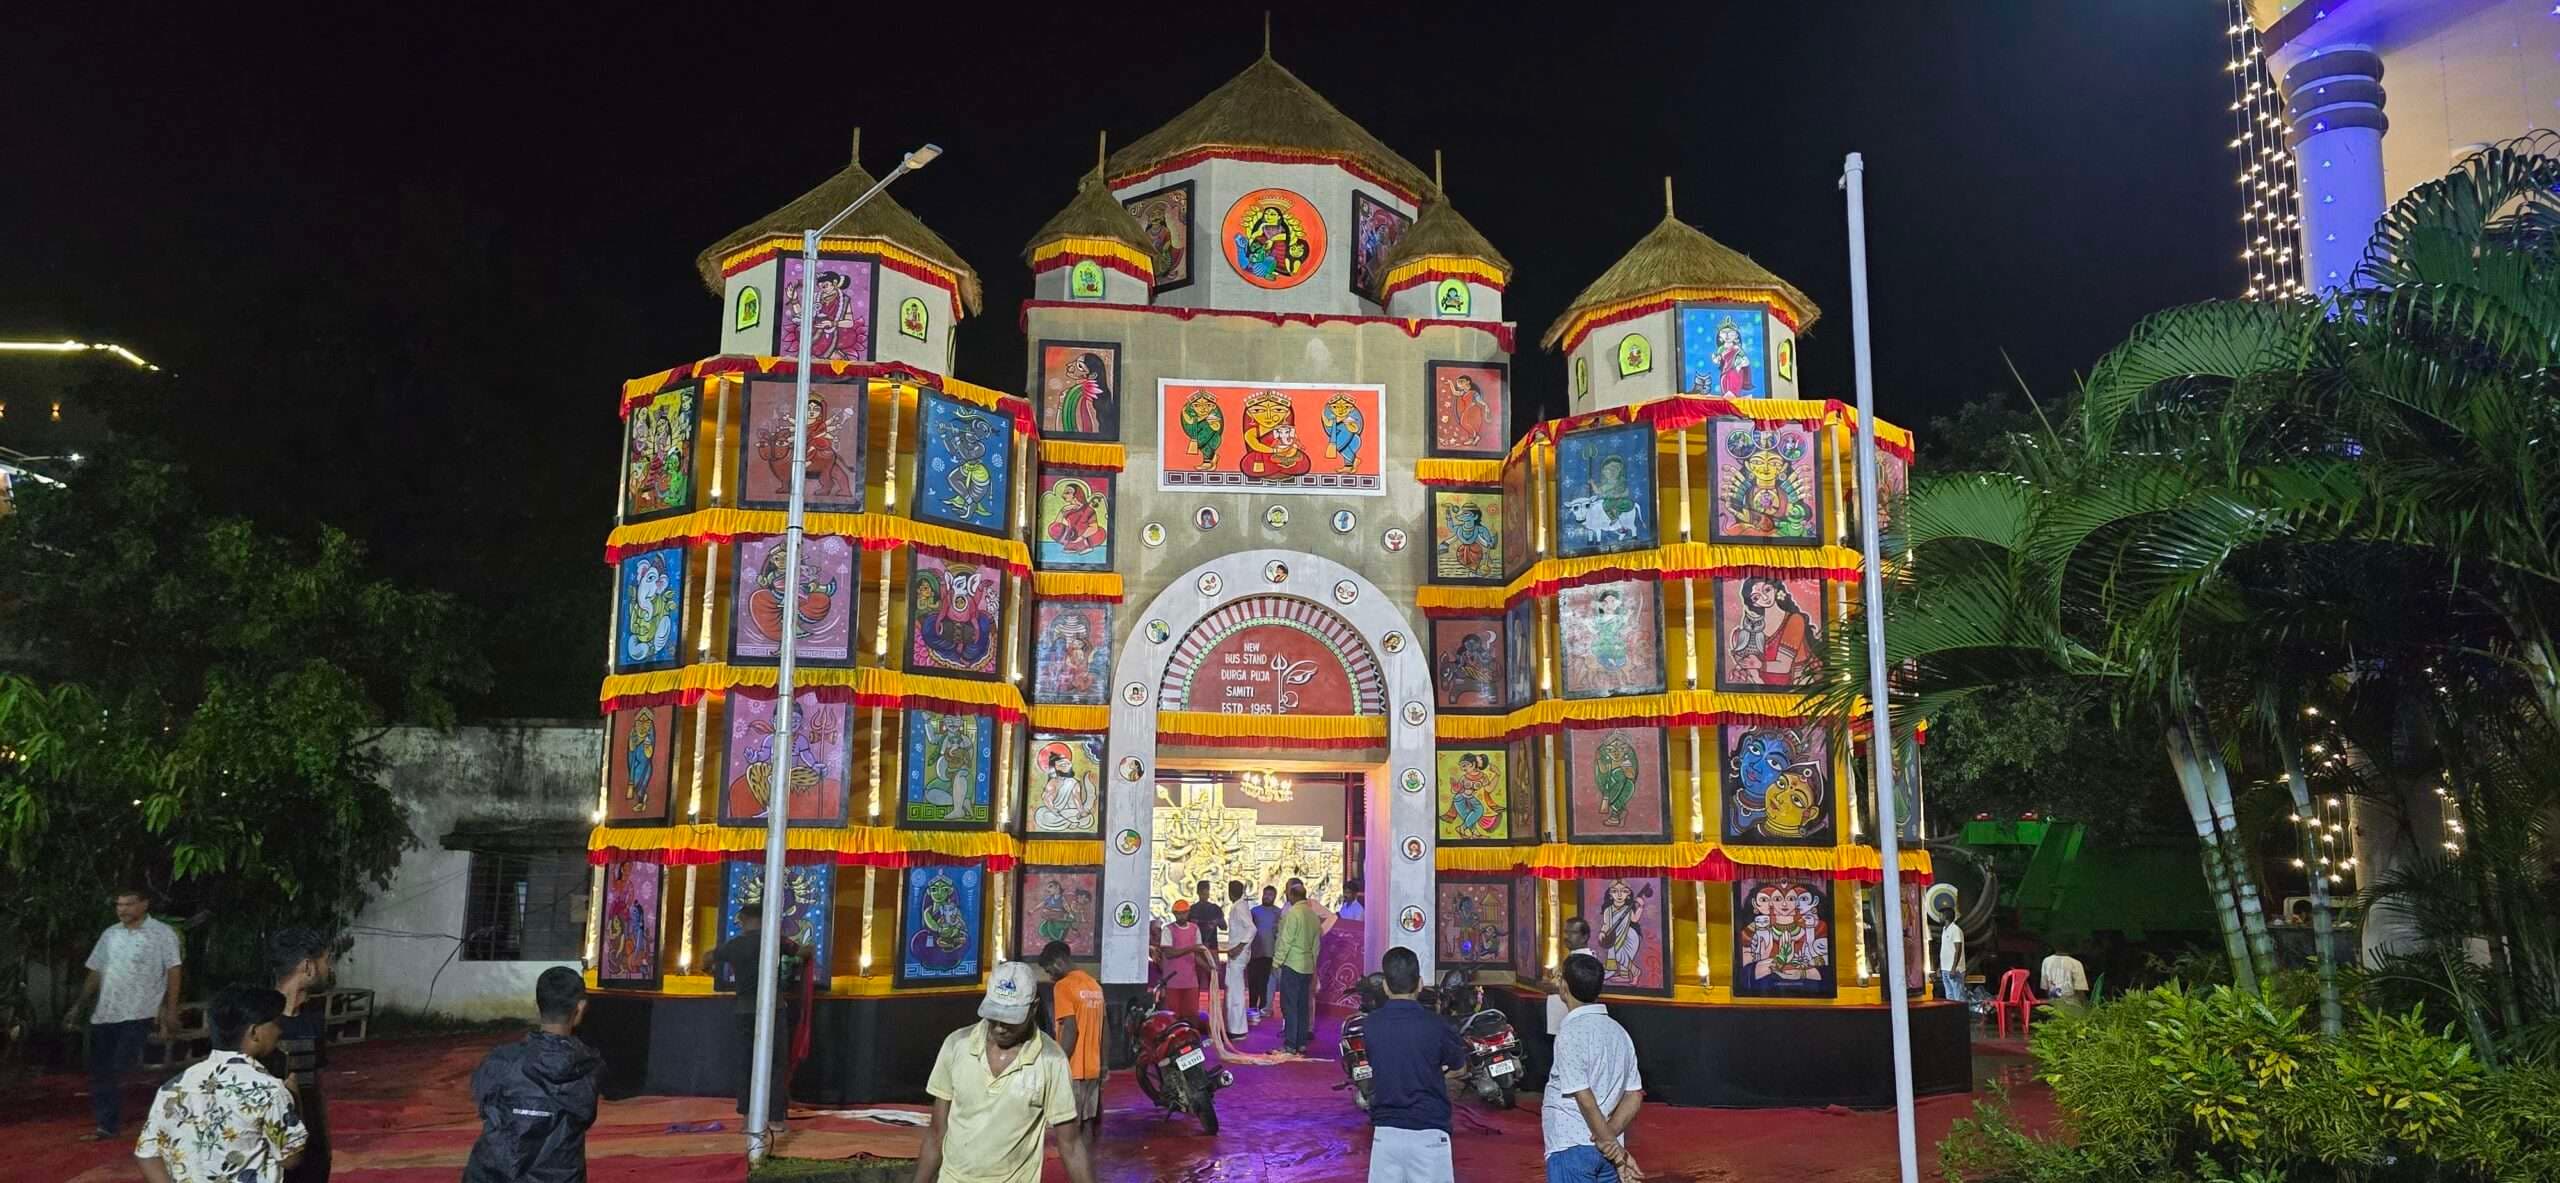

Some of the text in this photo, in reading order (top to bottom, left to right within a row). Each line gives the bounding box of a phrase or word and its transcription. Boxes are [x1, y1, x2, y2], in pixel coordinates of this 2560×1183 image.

[1243, 642, 1260, 652] NEW
[1225, 653, 1267, 665] BUS STAND
[1221, 669, 1270, 682] DURGA PUJA
[1226, 686, 1254, 697] SAMITI
